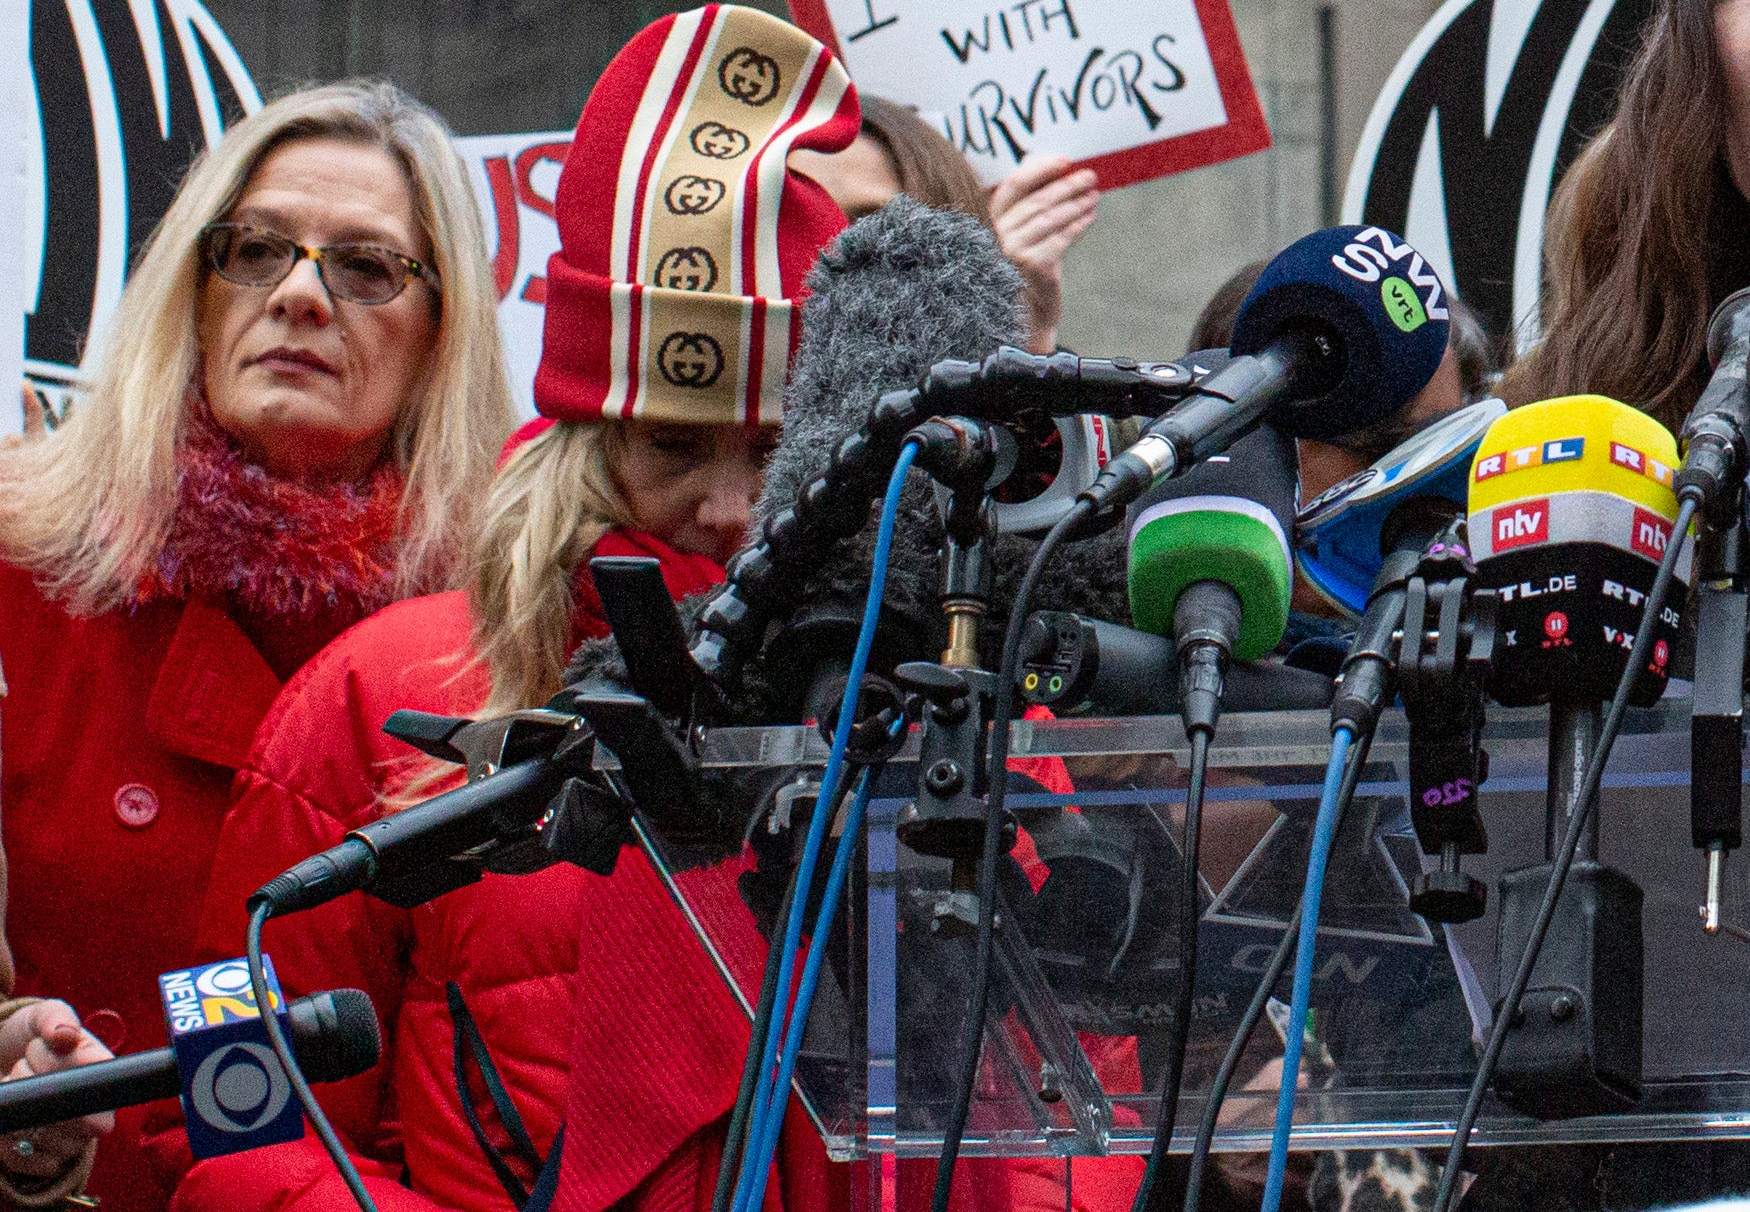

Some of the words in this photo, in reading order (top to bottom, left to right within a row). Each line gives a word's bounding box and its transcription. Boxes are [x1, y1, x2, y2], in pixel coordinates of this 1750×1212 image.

[1391, 284, 1414, 323] vrt
[1478, 442, 1577, 477] RTL
[1614, 445, 1672, 480] RT
[1498, 509, 1542, 541] ntv
[1499, 574, 1577, 603] TL.DE
[161, 970, 205, 1032] NEWS
